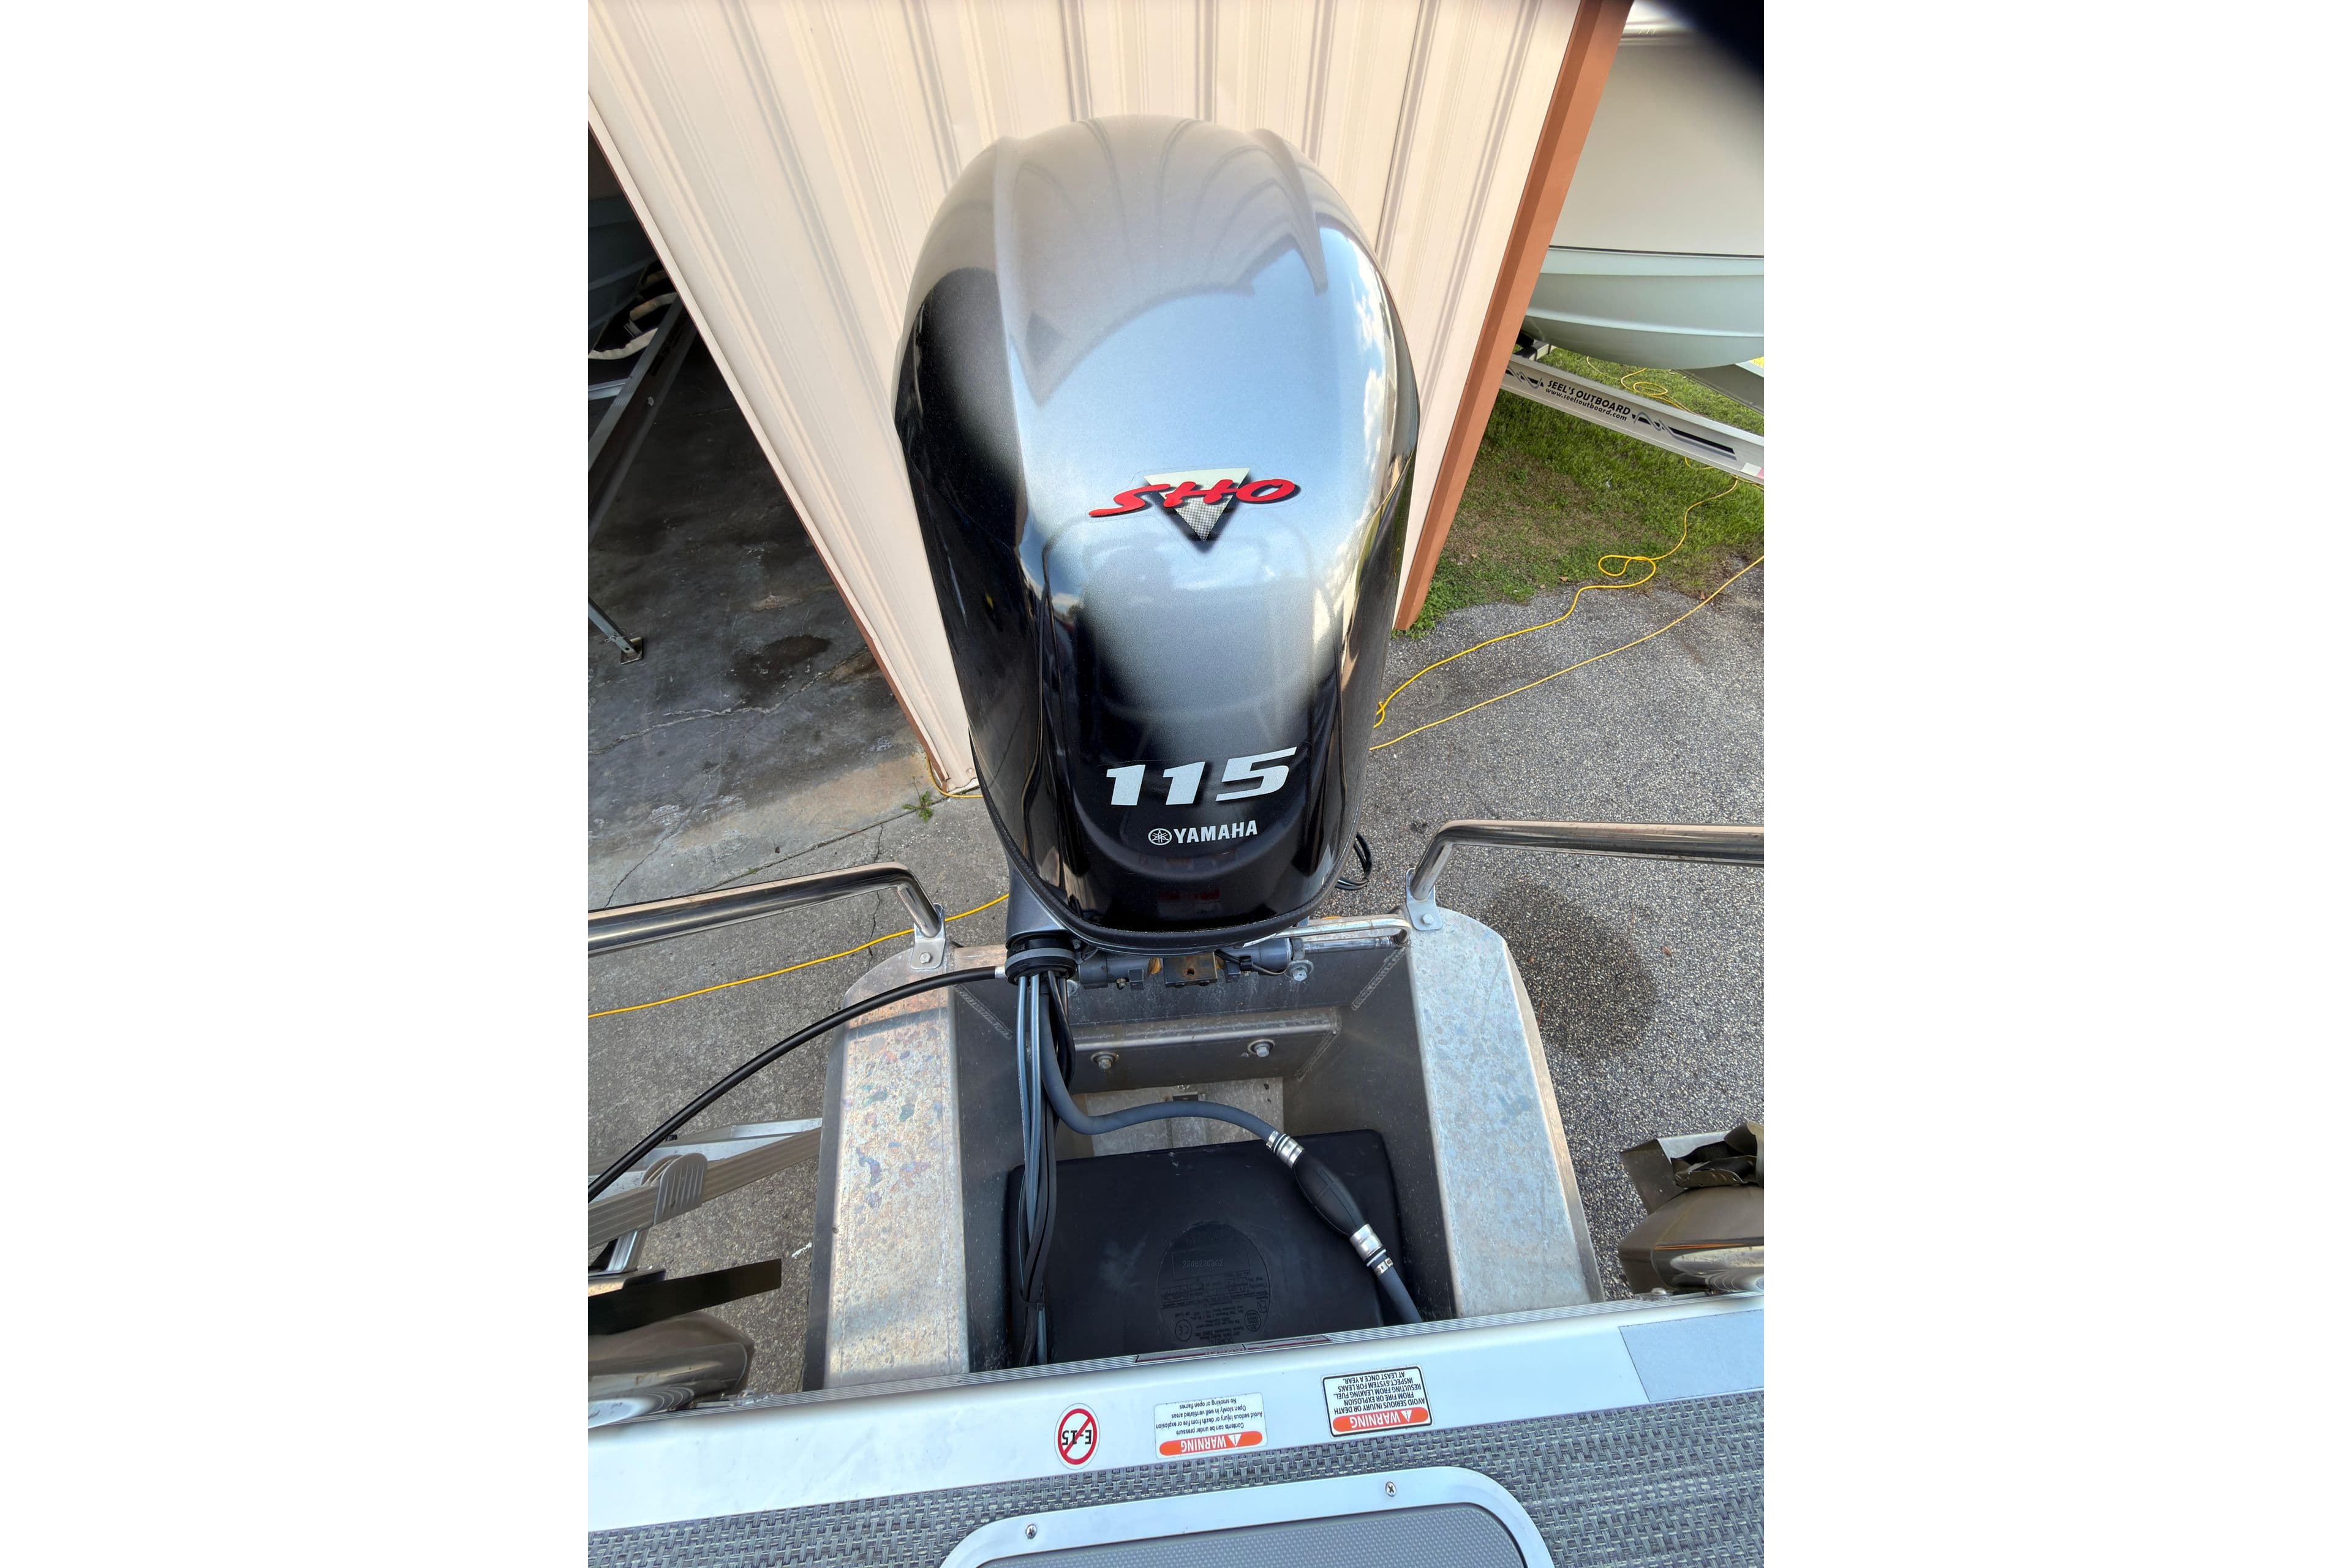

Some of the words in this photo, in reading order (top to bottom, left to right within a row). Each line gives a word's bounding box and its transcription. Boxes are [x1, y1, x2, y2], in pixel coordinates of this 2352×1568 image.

[1548, 380, 1575, 395] SEEL'S
[1576, 390, 1630, 415] OUTBOARD
[1546, 388, 1627, 421] www.seelsoutboard.com
[1088, 478, 1295, 517] SHO
[1106, 746, 1297, 806] 115
[1173, 820, 1258, 843] YAMAHA
[1365, 1374, 1379, 1382] ONCE
[1381, 1372, 1397, 1381] LEAST
[1374, 1387, 1390, 1395] FROM
[1392, 1384, 1421, 1393] RESULTING
[1350, 1389, 1374, 1398] LEAKING
[1212, 1398, 1229, 1407] smoking
[1344, 1396, 1374, 1406] EXPLOSION
[1383, 1400, 1406, 1409] SERIOUS
[1408, 1397, 1425, 1406] AVOID
[1363, 1402, 1382, 1411] INJURY
[1221, 1414, 1233, 1422] injury
[1350, 1411, 1400, 1428] WARNING
[1156, 1421, 1177, 1430] explosion
[1062, 1430, 1091, 1446] E-15
[1181, 1436, 1226, 1452] WARNING
